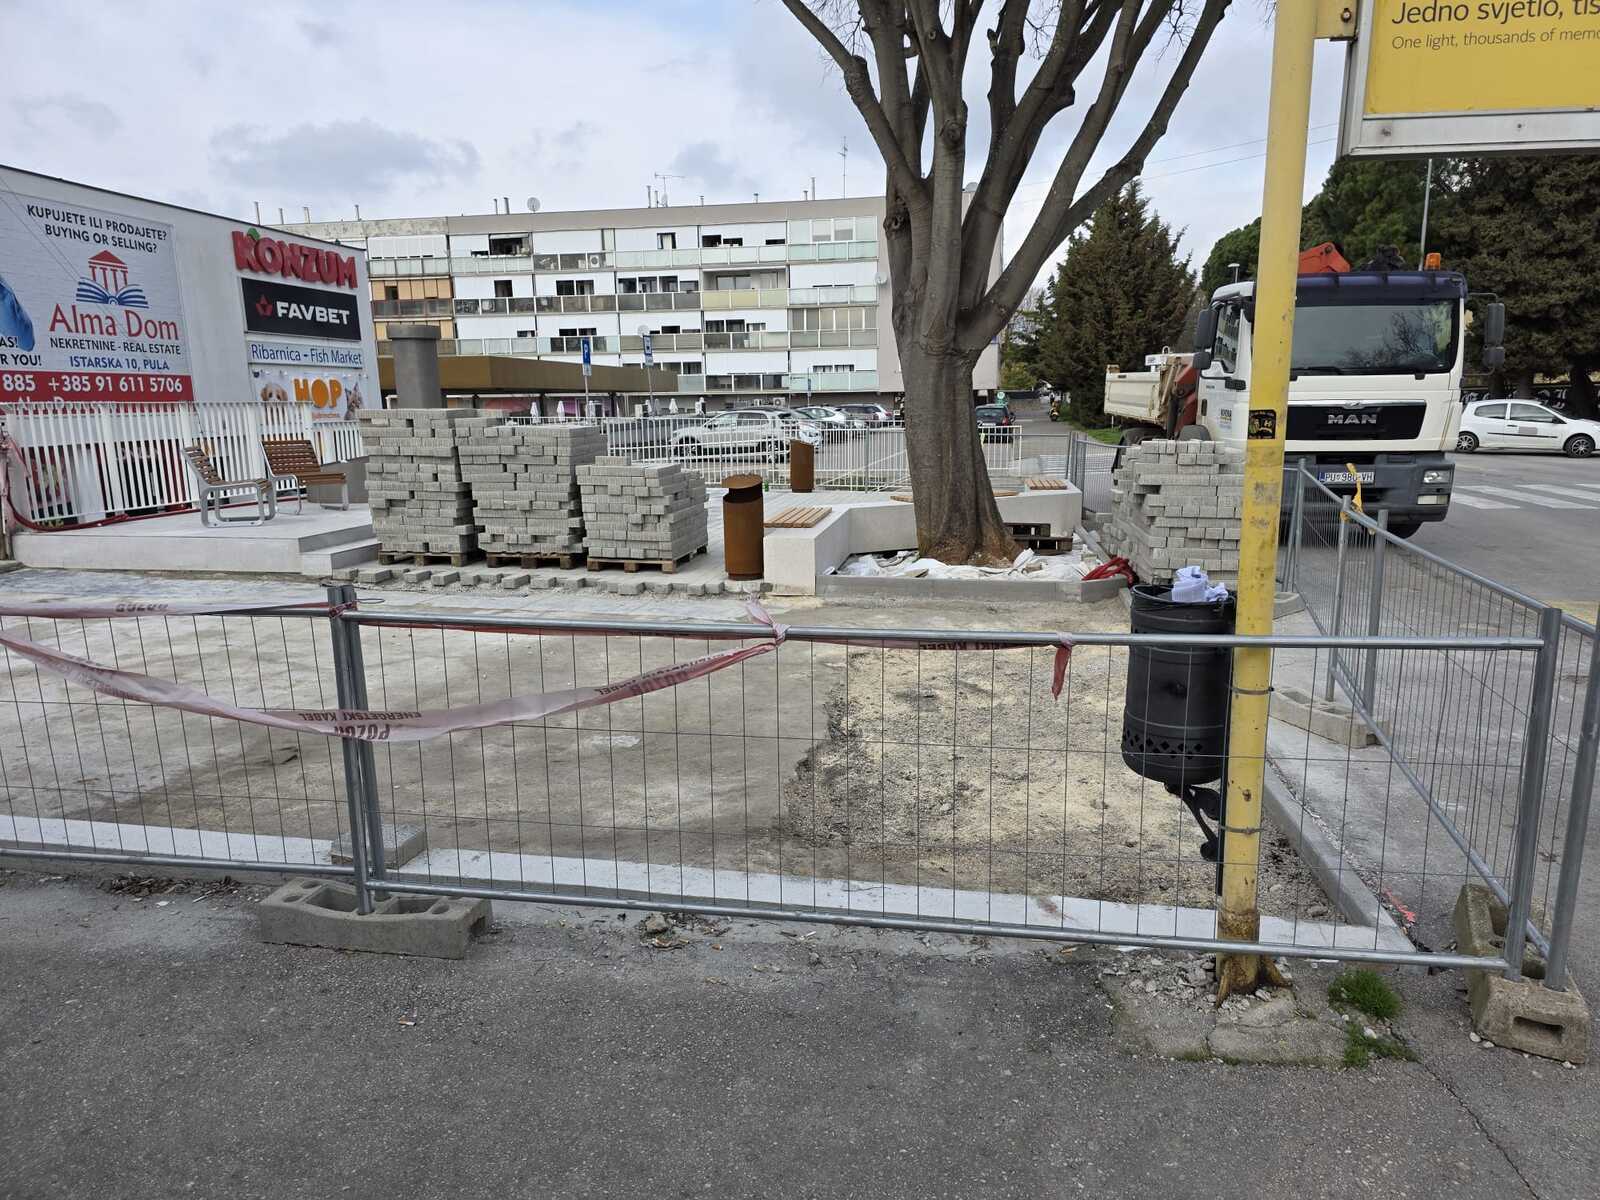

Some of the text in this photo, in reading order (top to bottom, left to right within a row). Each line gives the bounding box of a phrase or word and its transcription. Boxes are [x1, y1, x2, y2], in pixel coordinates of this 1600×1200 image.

[1392, 0, 1469, 24] Jedno
[1477, 0, 1563, 24] svjetlo,
[1392, 36, 1422, 49] One
[1426, 33, 1458, 51] light,
[1464, 29, 1536, 46] thousands
[1540, 27, 1557, 42] of
[27, 204, 167, 240] KUPUJETE ILI PRODAJETE?
[45, 223, 157, 253] BUYING OR SELLING?
[231, 230, 358, 289] KONZUM
[49, 303, 179, 340] Alma Dom
[276, 301, 350, 325] FAVBET
[50, 337, 117, 351] NEKRETNINE
[123, 341, 147, 353] REAL
[149, 343, 181, 355] ESTATE
[251, 343, 301, 361] Ribarnica
[310, 348, 330, 364] Fish
[331, 349, 362, 365] Market
[11, 353, 42, 366] YOU!
[70, 355, 170, 371] ISTARSKA 10, PULA
[2, 374, 183, 392] 885 +385 91 611 5706
[292, 377, 343, 409] HOP
[1327, 414, 1377, 425] MAN
[298, 712, 337, 722] KABEL
